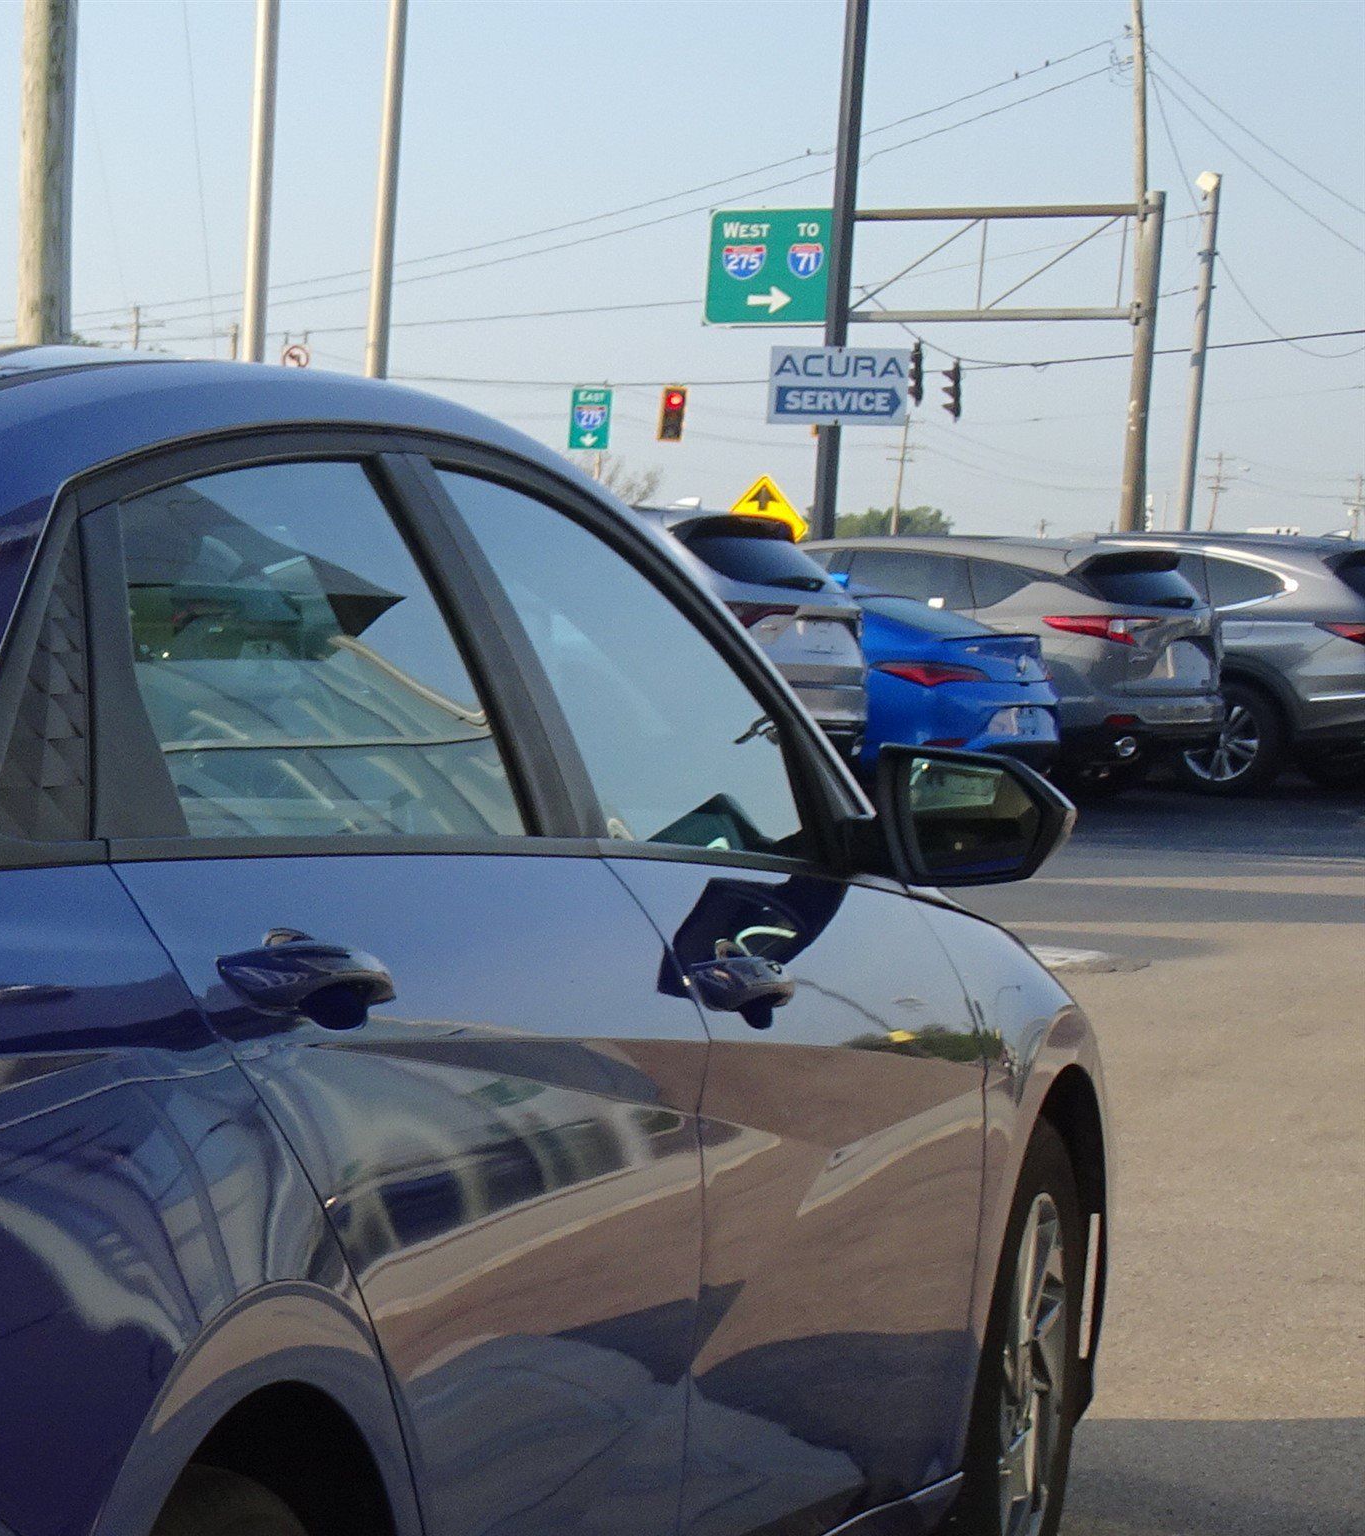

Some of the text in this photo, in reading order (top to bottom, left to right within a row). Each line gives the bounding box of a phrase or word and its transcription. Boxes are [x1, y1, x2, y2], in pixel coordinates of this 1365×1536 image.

[722, 221, 820, 239] WEST TO
[727, 252, 816, 272] 275 71
[774, 354, 904, 378] ACURA
[784, 390, 891, 412] SERVICE
[581, 410, 602, 426] 275
